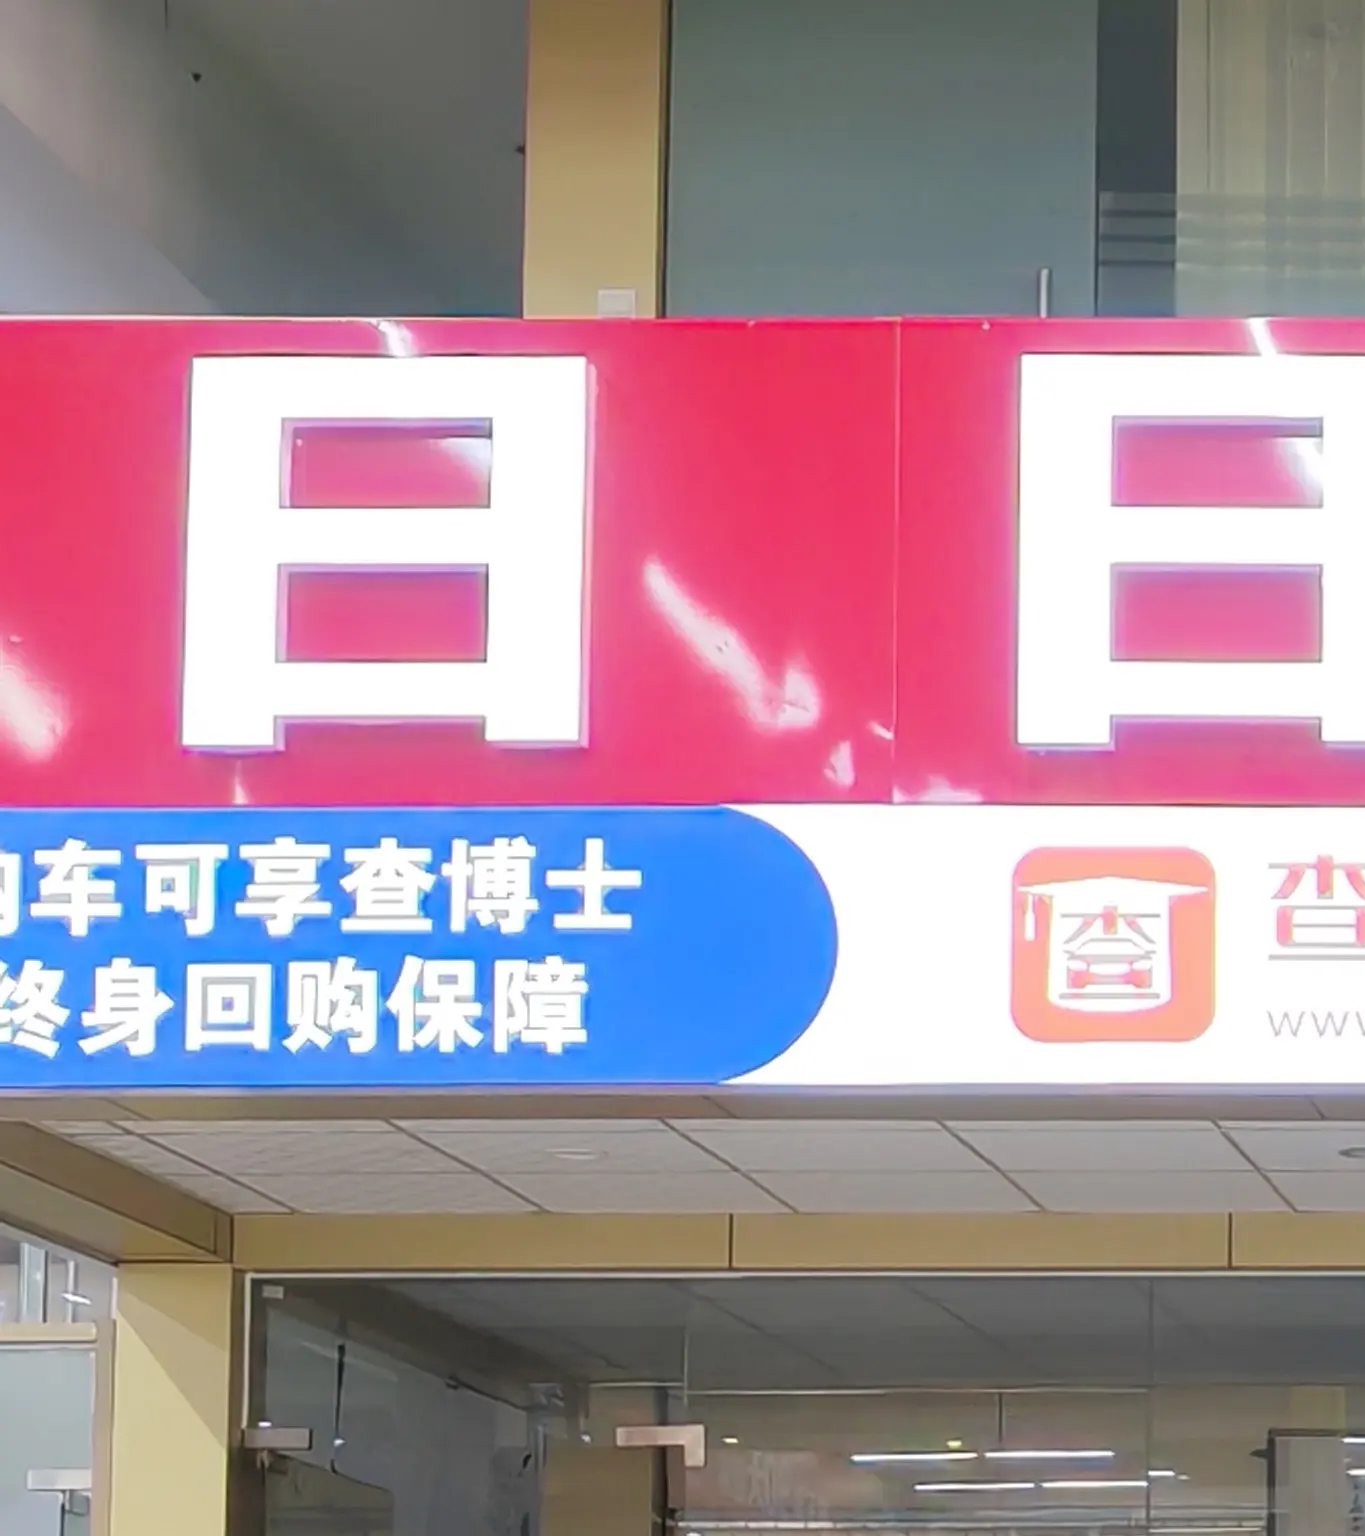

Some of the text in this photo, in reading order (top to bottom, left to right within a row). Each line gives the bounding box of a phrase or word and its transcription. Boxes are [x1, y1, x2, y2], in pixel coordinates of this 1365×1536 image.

[0, 836, 642, 937] 车可享查博士
[0, 955, 590, 1058] 终身回购保障
